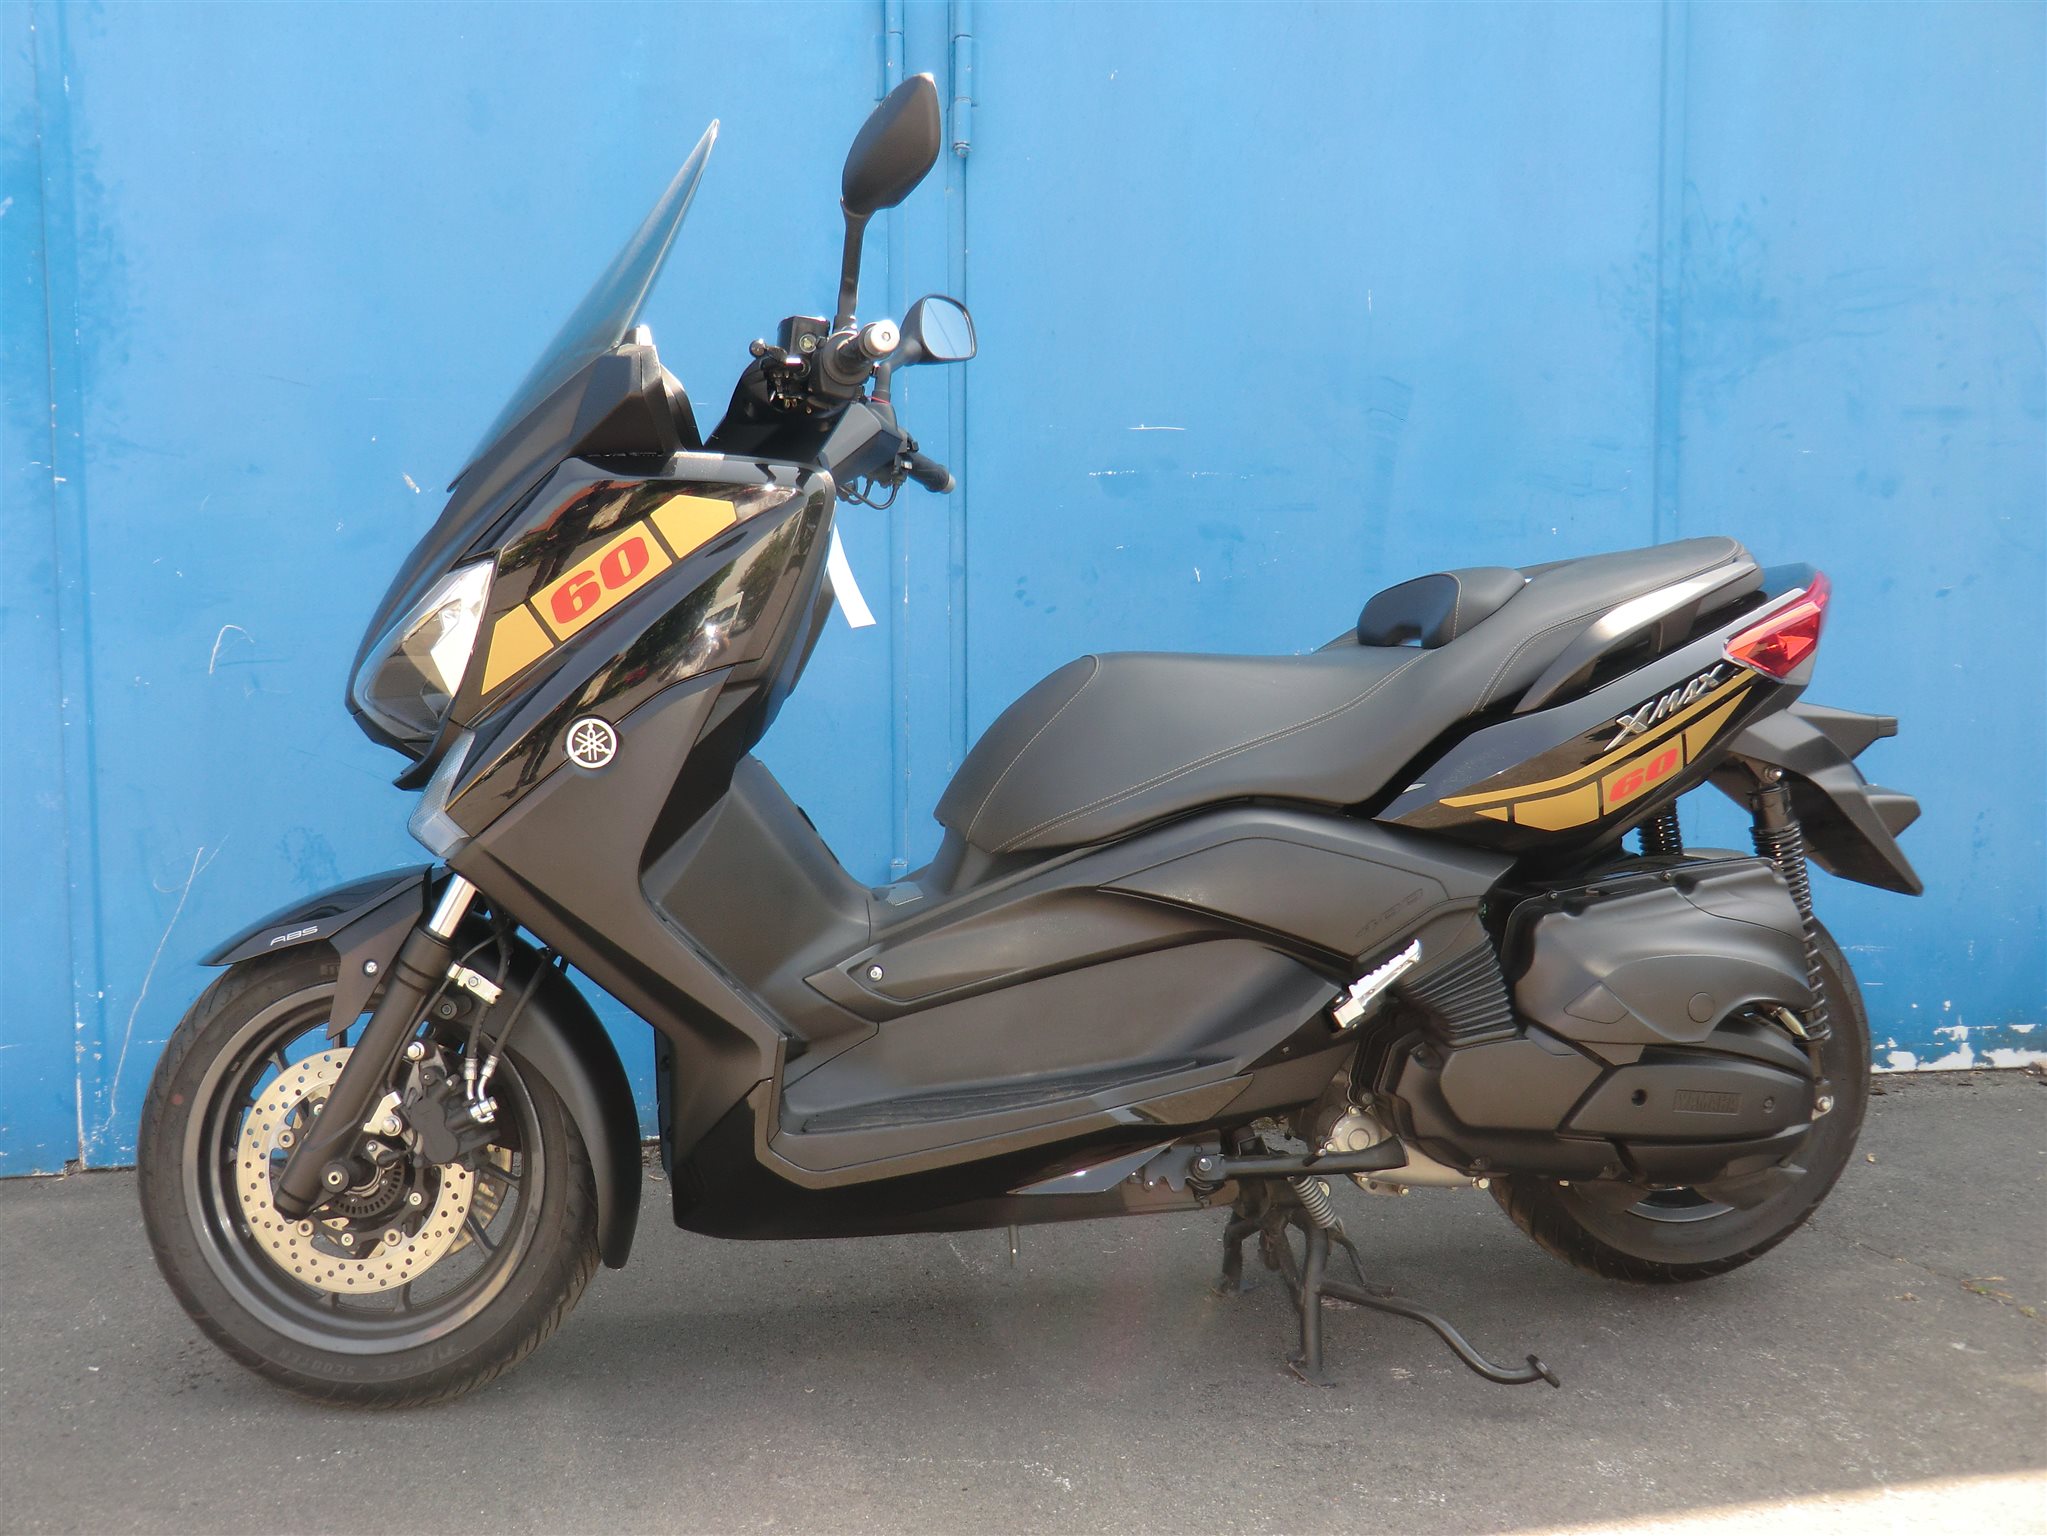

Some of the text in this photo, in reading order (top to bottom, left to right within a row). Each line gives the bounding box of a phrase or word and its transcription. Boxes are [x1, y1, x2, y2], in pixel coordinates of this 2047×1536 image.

[550, 537, 650, 624] 60
[1603, 663, 1724, 752] XMAX
[1609, 747, 1679, 802] 60
[269, 925, 319, 946] ABS
